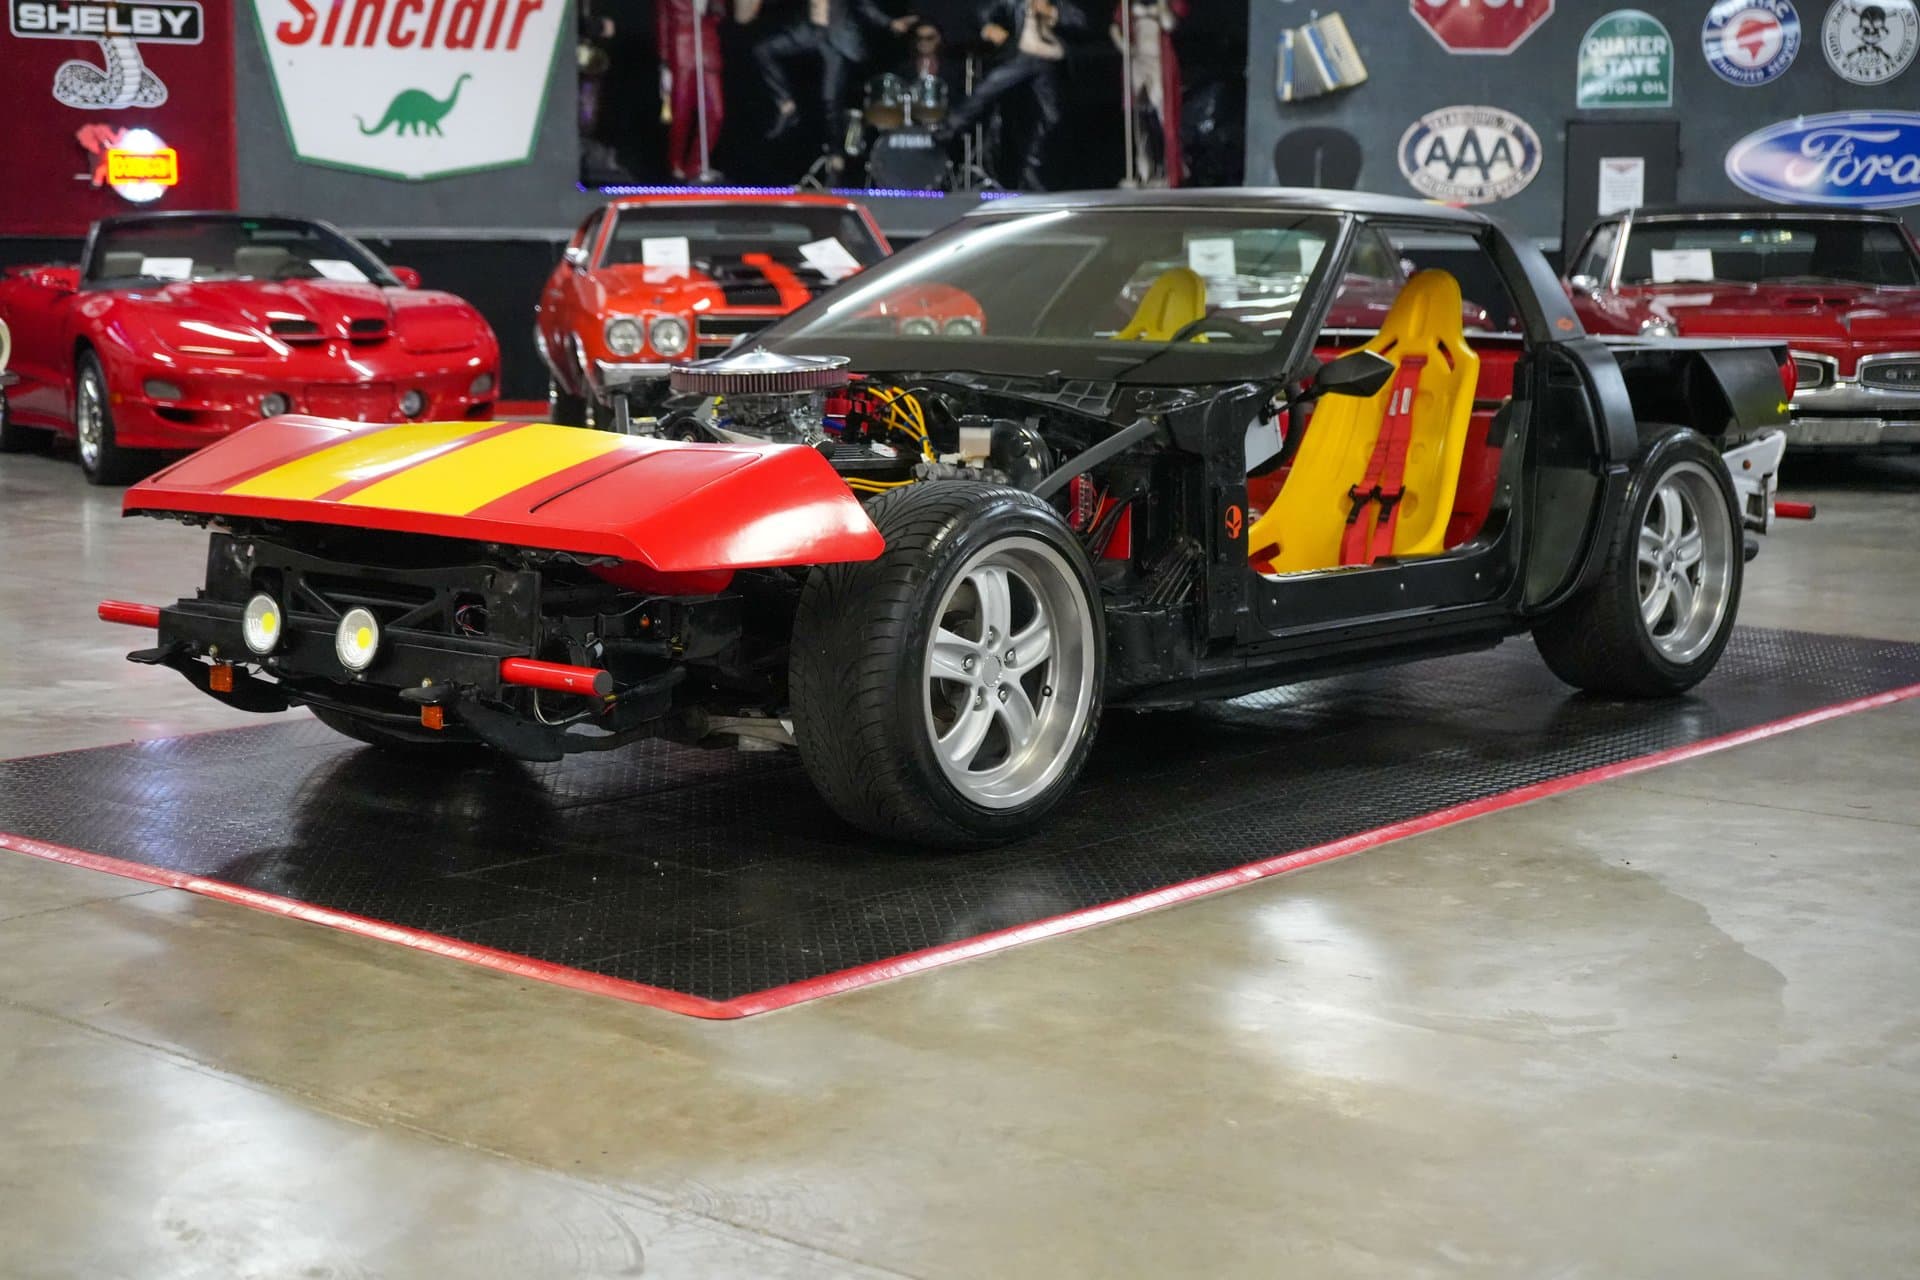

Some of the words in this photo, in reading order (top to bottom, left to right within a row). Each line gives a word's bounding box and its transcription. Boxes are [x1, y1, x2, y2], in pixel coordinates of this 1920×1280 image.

[18, 3, 192, 36] SHELBY
[276, 0, 543, 51] Sinclair
[1586, 35, 1667, 56] QUAKER
[1592, 56, 1661, 77] STATE
[1583, 81, 1638, 97] MOTOR
[1642, 80, 1667, 95] OIL
[1425, 127, 1514, 180] AAA
